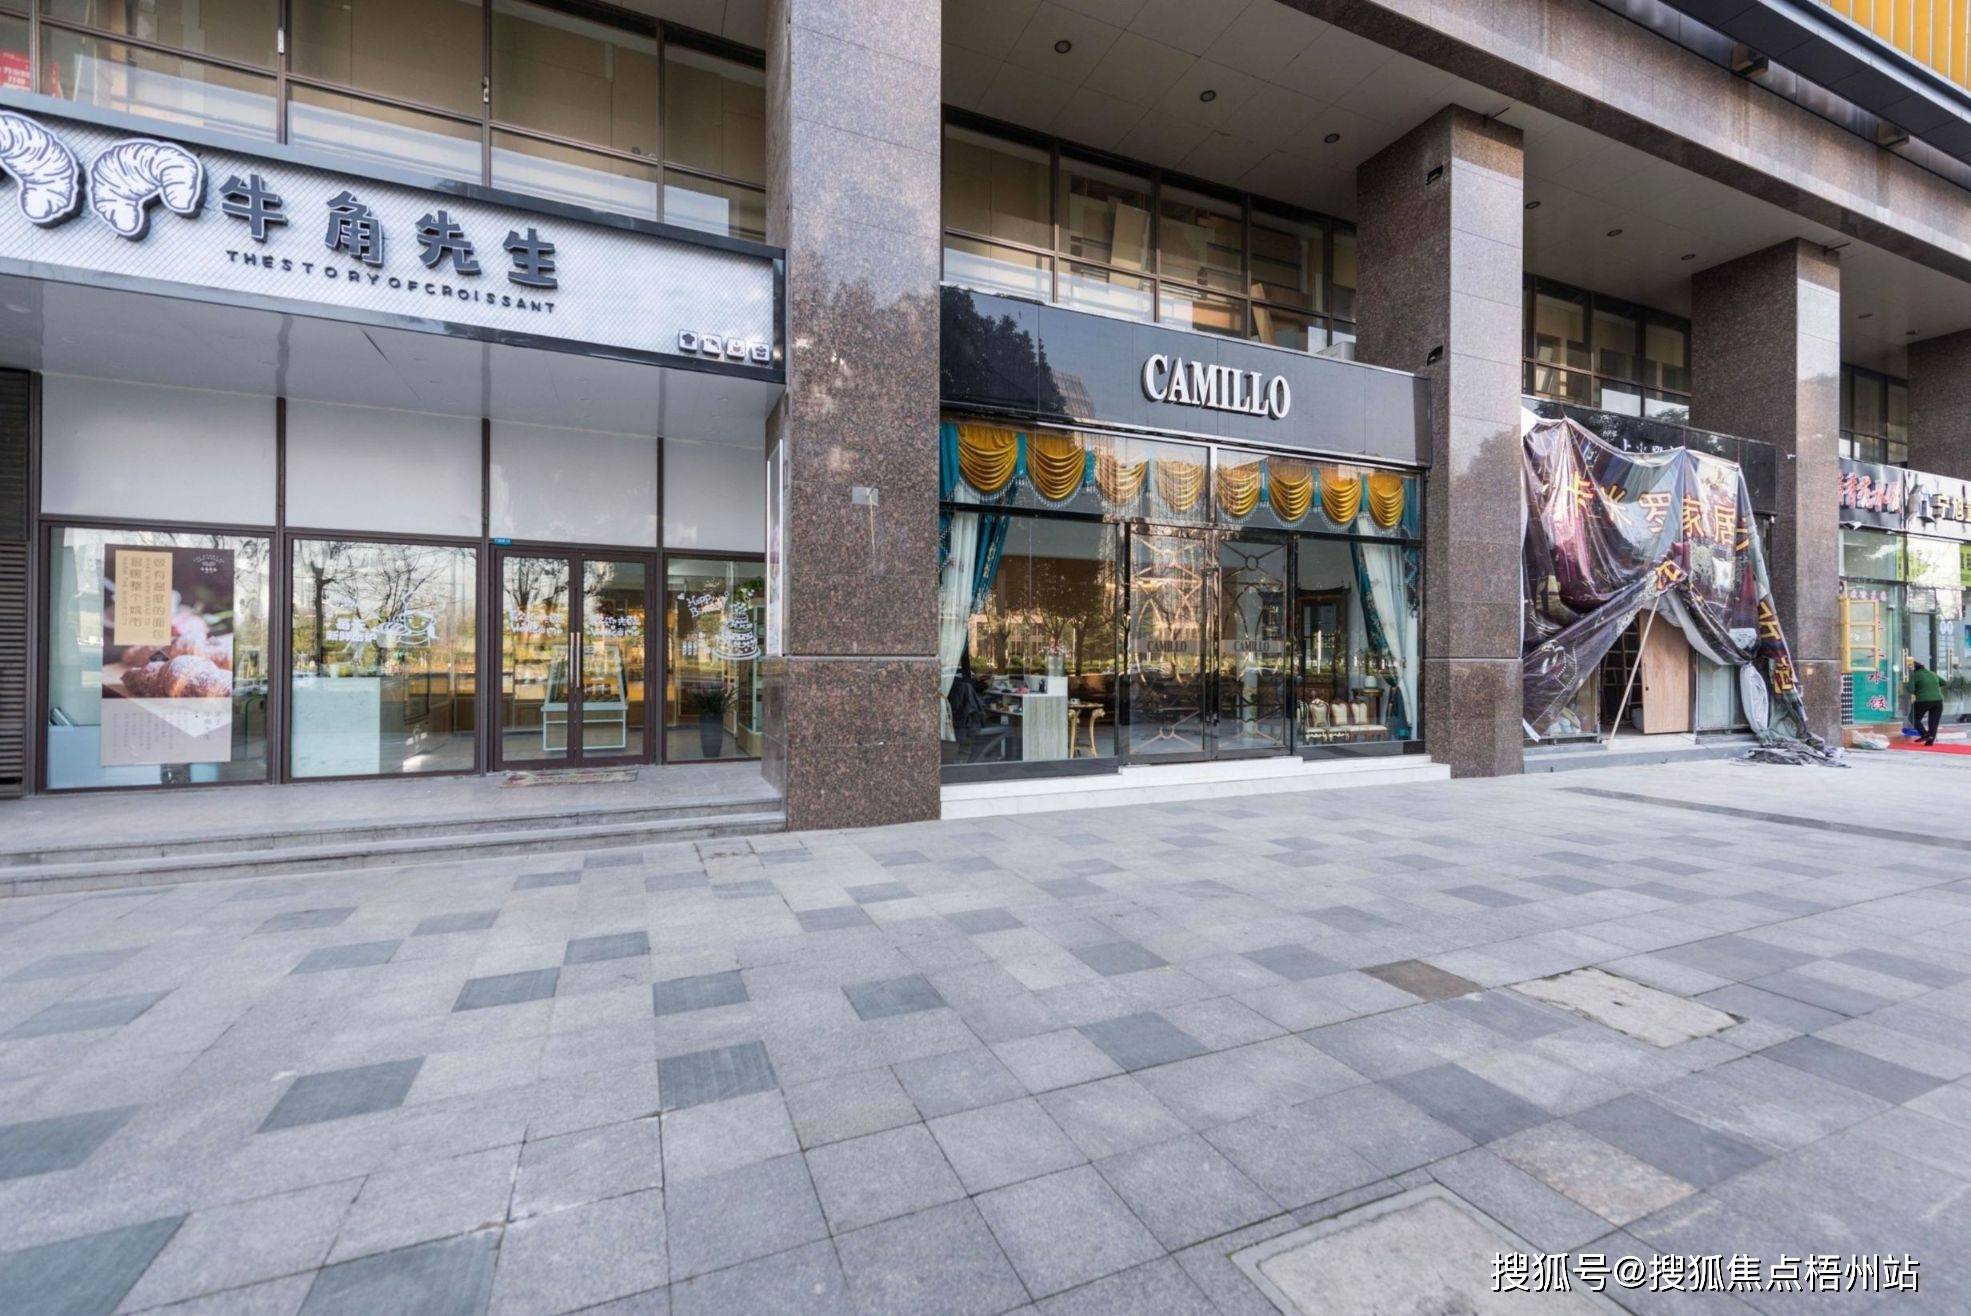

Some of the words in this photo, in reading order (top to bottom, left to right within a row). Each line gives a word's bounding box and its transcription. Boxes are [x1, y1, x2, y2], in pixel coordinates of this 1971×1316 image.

[219, 174, 559, 290] 牛角先生
[1142, 353, 1292, 420] CAMILLO
[1146, 640, 1187, 652] CAMILLO
[1233, 640, 1270, 652] CAMILLO
